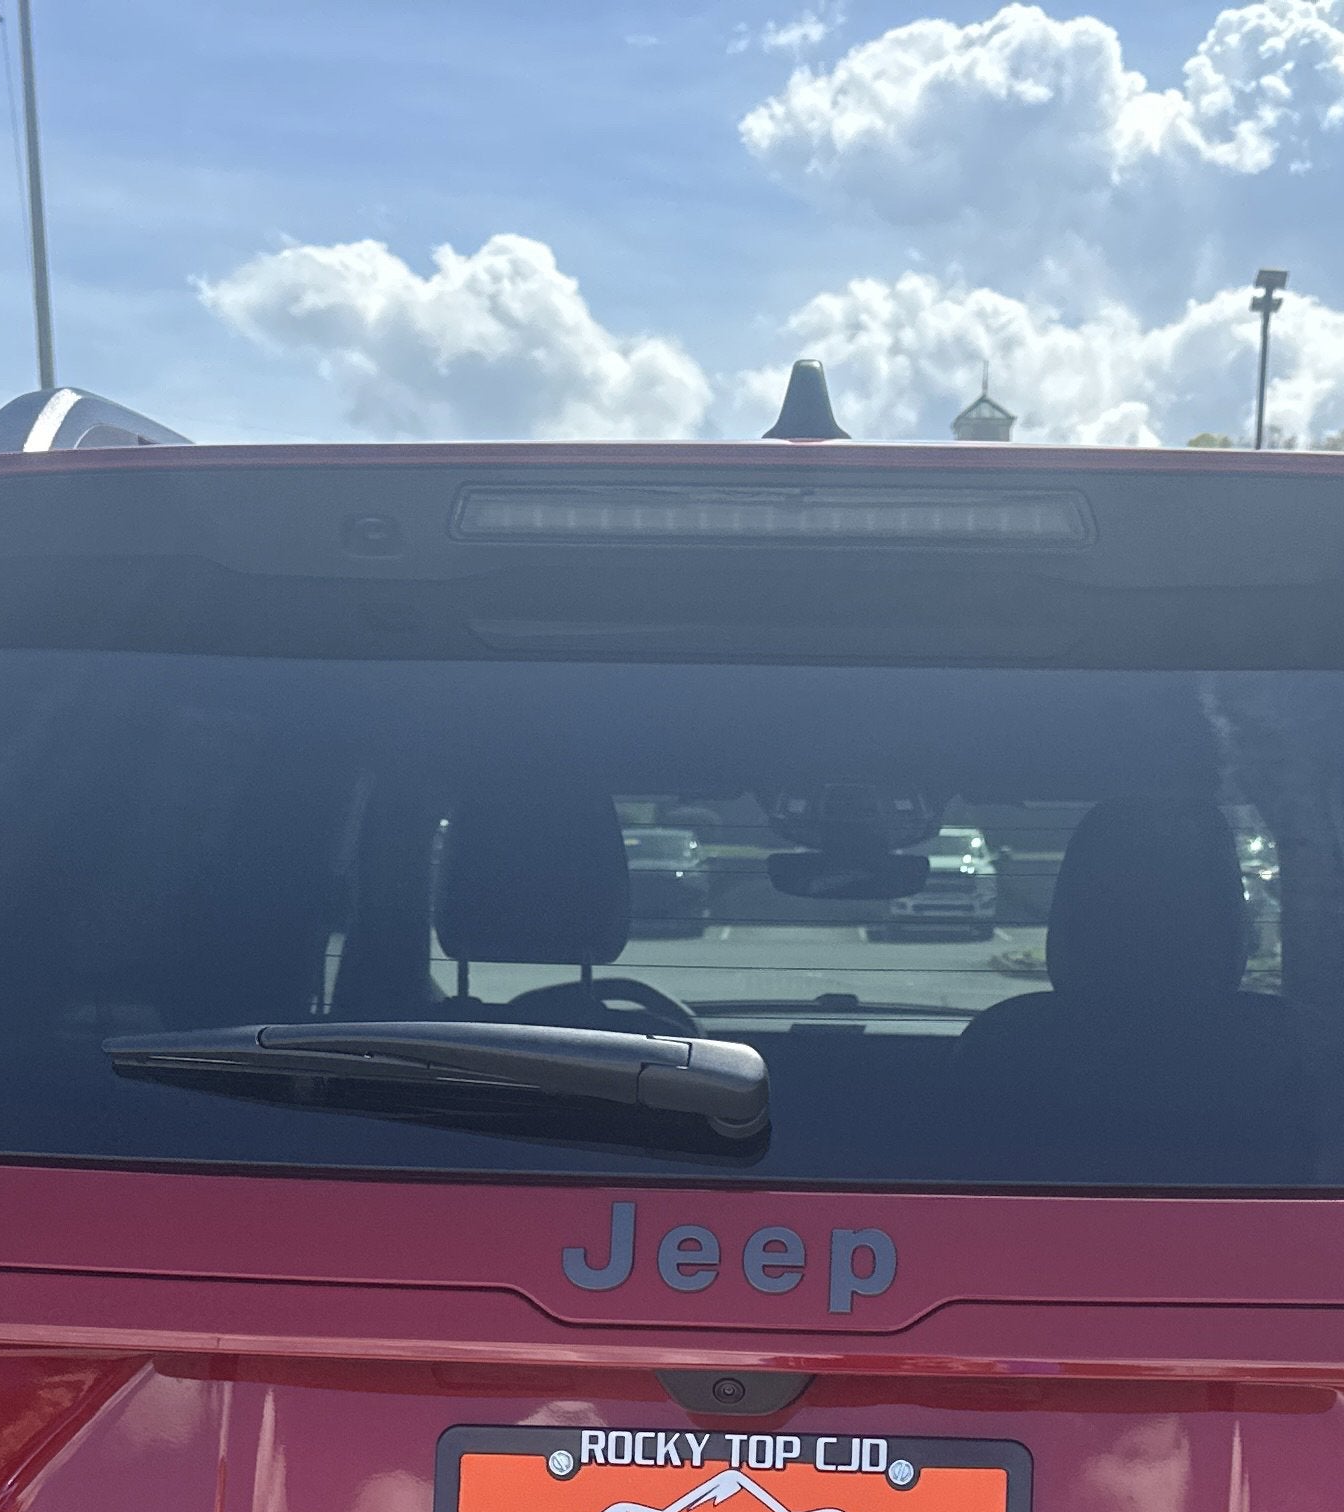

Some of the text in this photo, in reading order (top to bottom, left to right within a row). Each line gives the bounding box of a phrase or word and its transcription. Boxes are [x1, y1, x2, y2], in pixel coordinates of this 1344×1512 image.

[561, 1201, 898, 1314] Jeep
[580, 1429, 888, 1473] ROCKY TOP CJD
